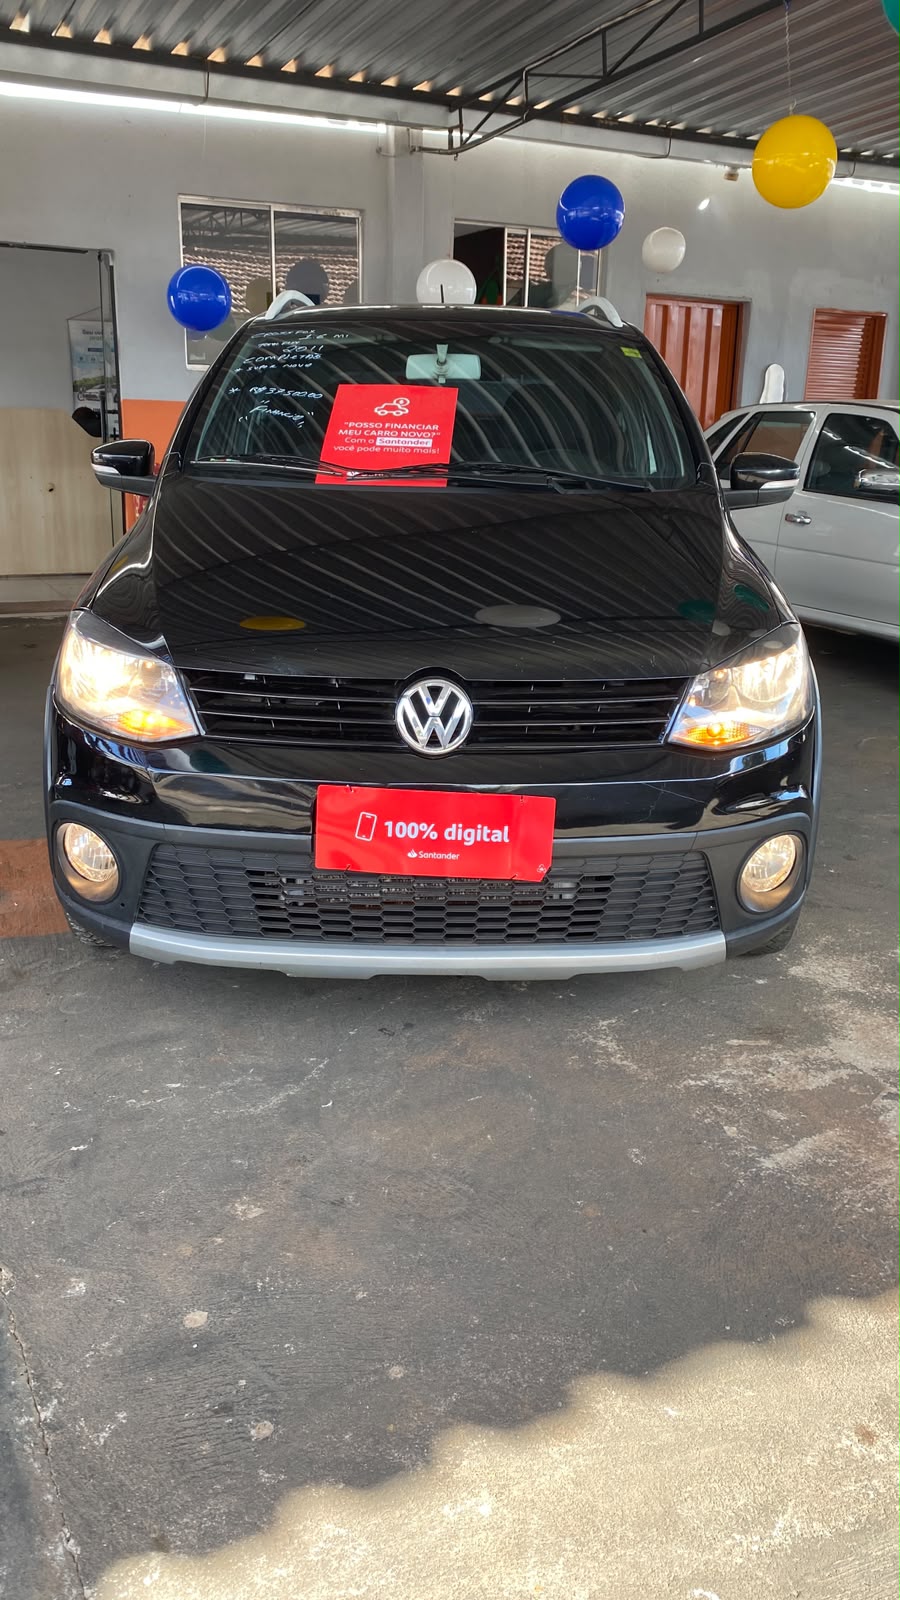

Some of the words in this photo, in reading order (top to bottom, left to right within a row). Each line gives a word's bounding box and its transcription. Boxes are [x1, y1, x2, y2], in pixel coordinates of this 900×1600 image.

[282, 344, 324, 353] 2011
[344, 421, 383, 429] "POSSO
[384, 422, 440, 431] FINANCIAR
[363, 429, 399, 437] CARRO
[400, 430, 441, 438] NOVO?"
[344, 436, 366, 444] Com
[378, 437, 431, 446] Santander
[383, 446, 411, 454] muito
[384, 820, 438, 840] 100%
[443, 823, 510, 846] digital
[418, 850, 460, 861] Santander
